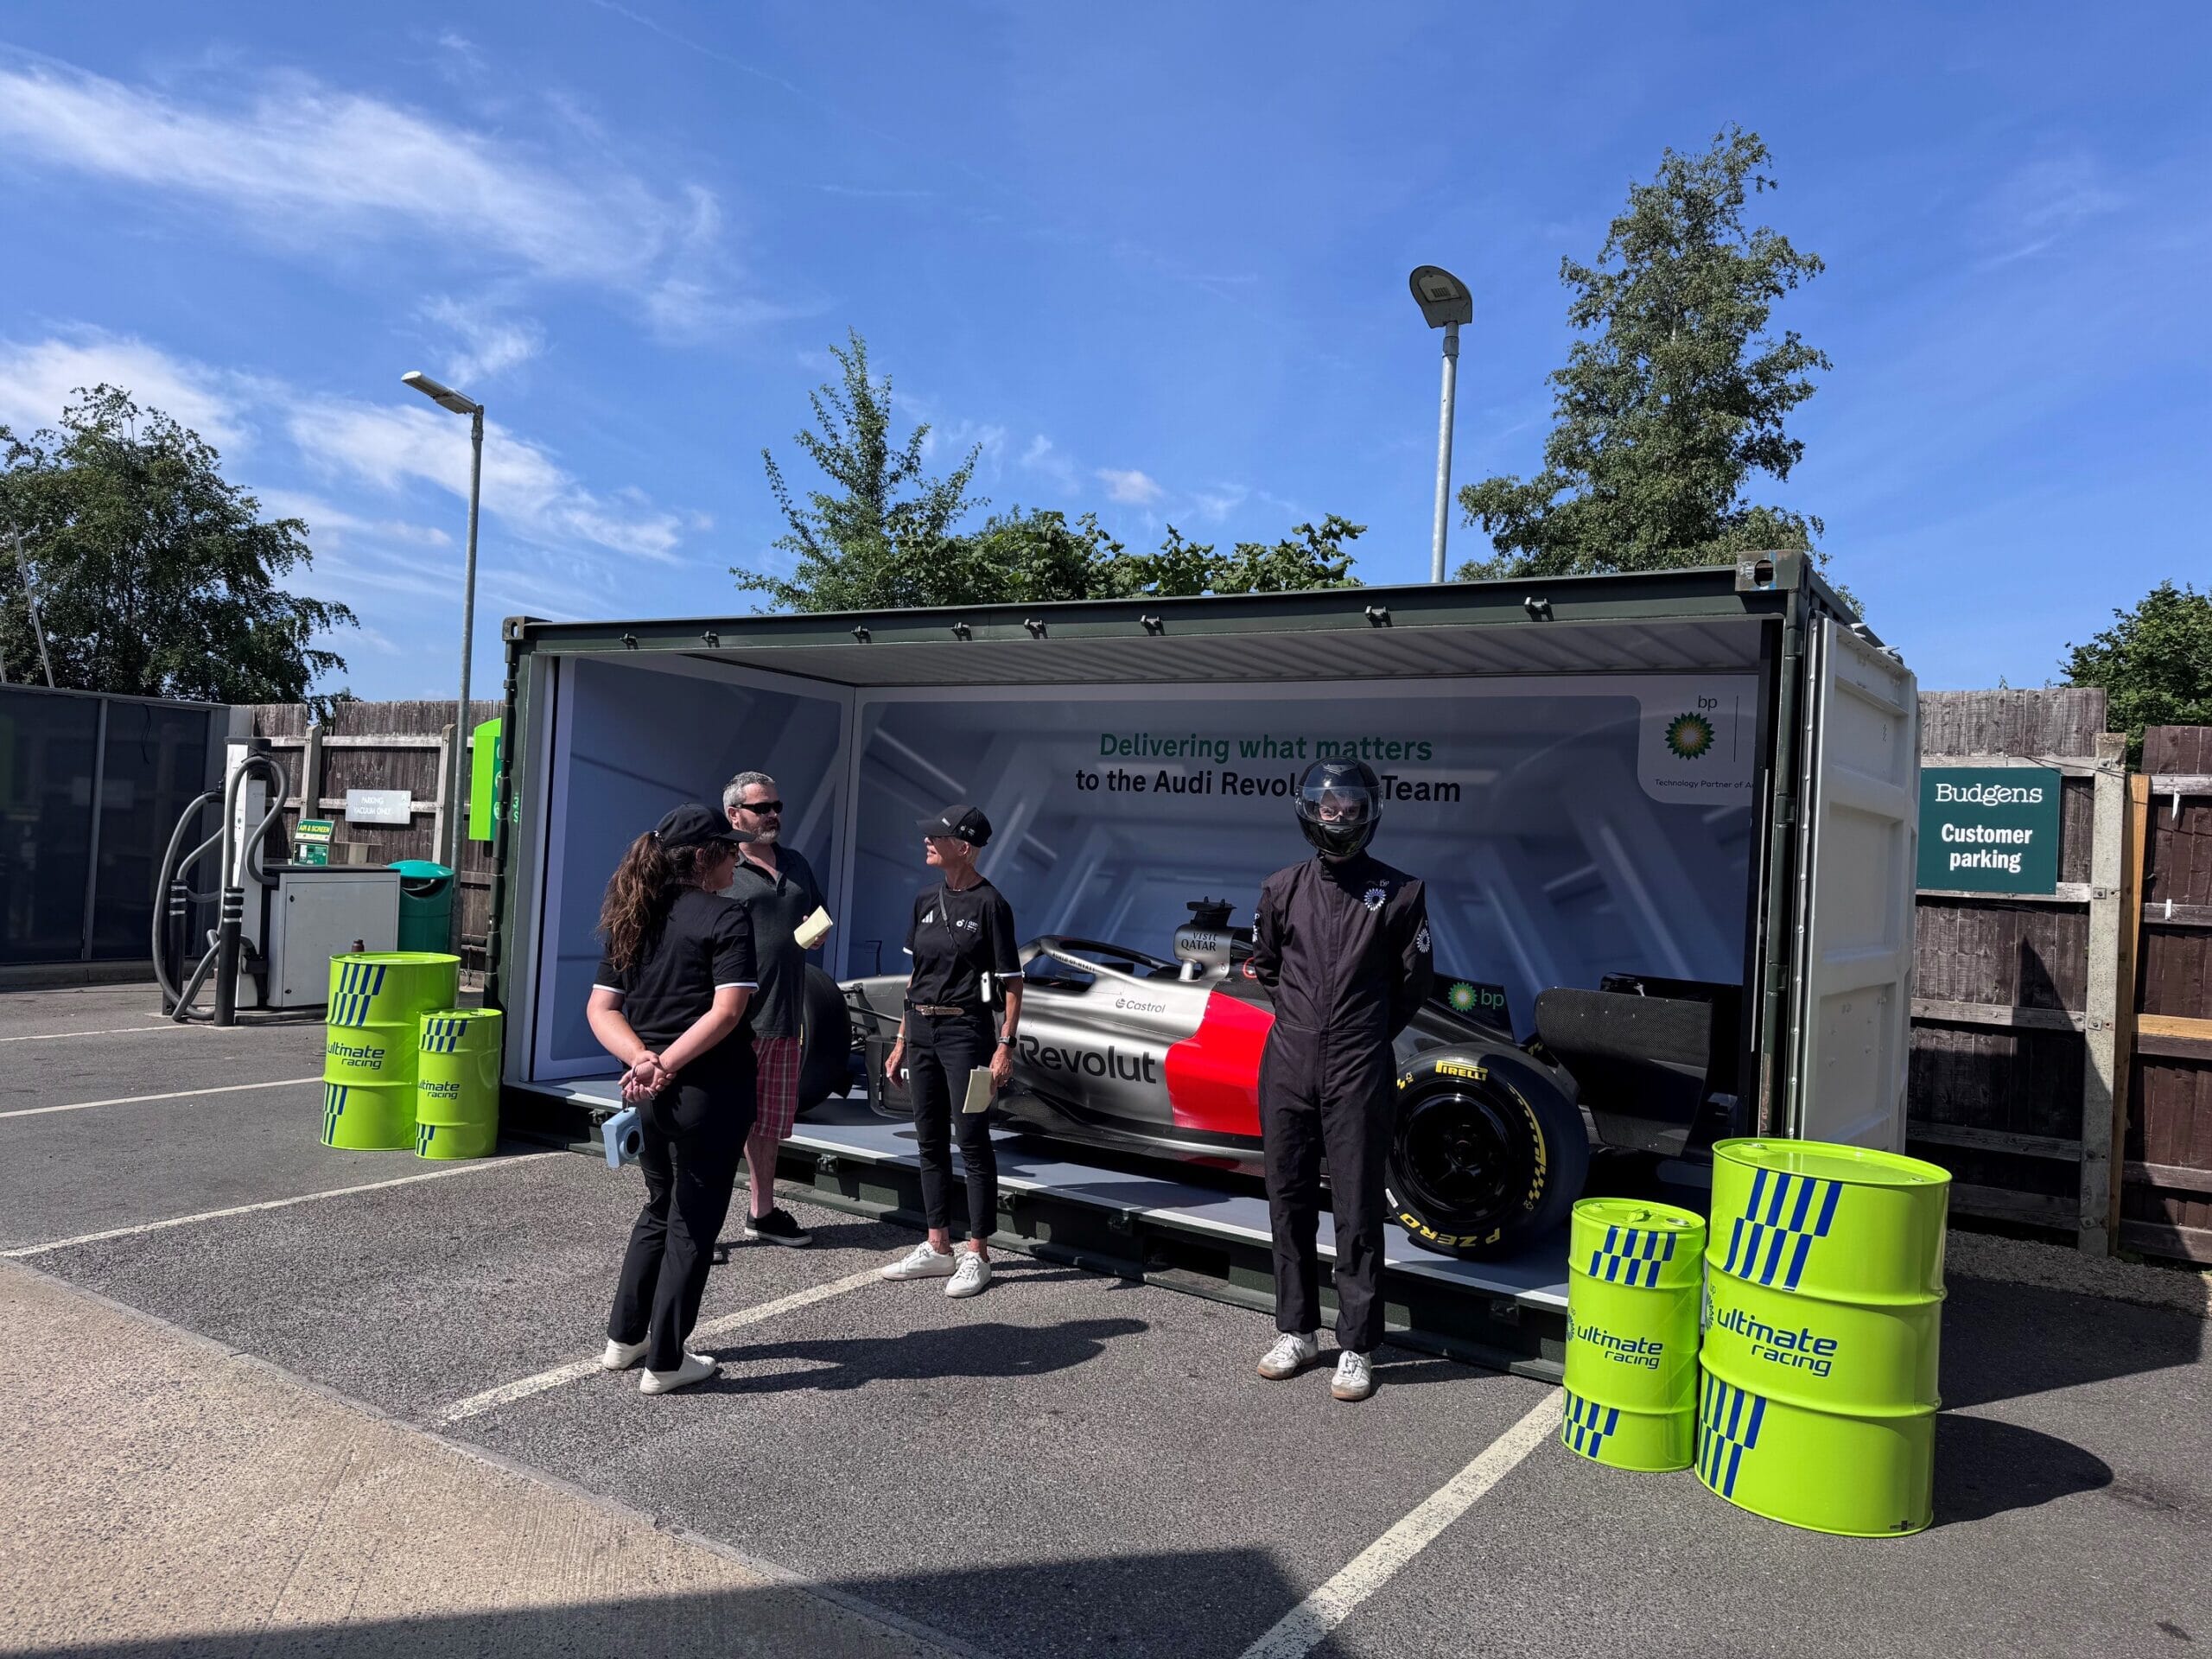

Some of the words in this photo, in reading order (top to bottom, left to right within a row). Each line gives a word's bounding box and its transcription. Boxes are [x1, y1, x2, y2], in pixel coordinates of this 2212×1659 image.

[1698, 695, 1718, 711] bp
[1100, 733, 1230, 764] Delivering
[1238, 734, 1306, 760] what
[1316, 736, 1432, 760] matters
[1075, 769, 1099, 791] to
[1107, 768, 1146, 792] the
[1153, 770, 1211, 795] Audi
[1221, 772, 1297, 797] Revol
[1381, 774, 1461, 802] Team
[1655, 779, 1699, 788] Technology
[1700, 779, 1732, 788] Partner
[1936, 783, 2043, 806] Budgens
[353, 806, 376, 815] VACUUM
[1941, 823, 2033, 844] Customer
[1949, 849, 2022, 874] parking
[1181, 938, 1217, 951] QATAR
[1126, 1000, 1166, 1014] Castrol
[1481, 988, 1504, 1010] bp
[327, 1041, 385, 1059] ultimate
[1019, 1034, 1156, 1084] Revolut
[341, 1058, 382, 1071] racing
[1435, 1059, 1488, 1082] PIRELLI
[427, 1091, 458, 1100] racing
[1400, 1212, 1478, 1248] ZERO
[1484, 1227, 1501, 1244] P
[1577, 1325, 1663, 1356] ultimate
[1717, 1307, 1838, 1357] ultimate
[1604, 1350, 1660, 1370] racing
[1751, 1344, 1832, 1377] racing
